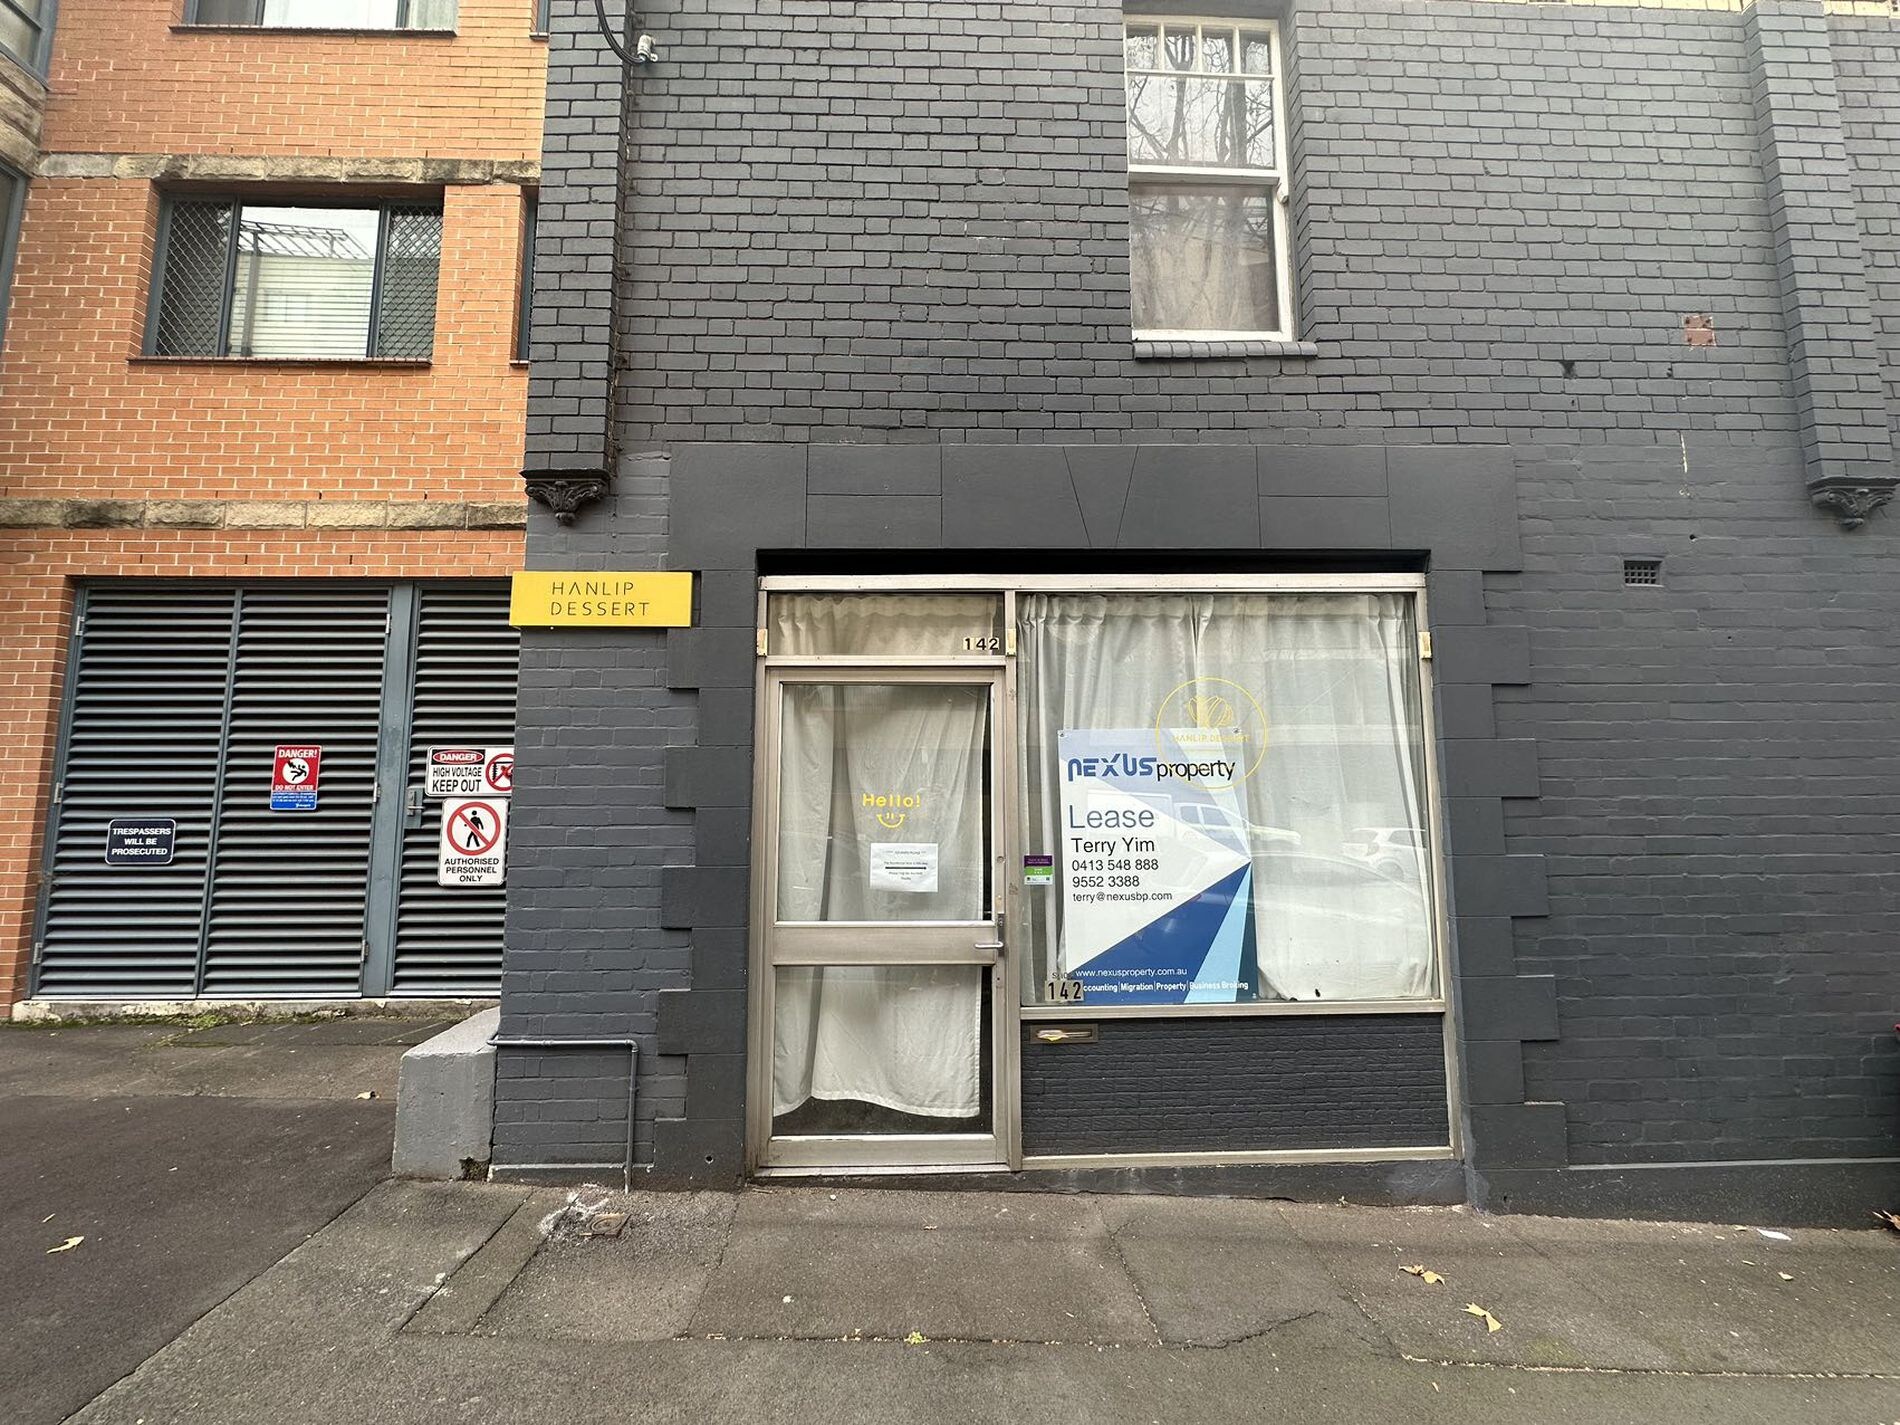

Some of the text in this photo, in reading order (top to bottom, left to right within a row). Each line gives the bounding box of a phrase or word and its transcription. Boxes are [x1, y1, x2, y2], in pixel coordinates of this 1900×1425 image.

[552, 581, 634, 596] HANLIP
[550, 601, 650, 616] DESSERT
[964, 637, 999, 651] 142
[278, 749, 318, 758] DANGER!
[440, 753, 477, 761] DANGER
[433, 767, 482, 777] HIGH VOLTAGE
[1156, 760, 1236, 782] property
[432, 779, 482, 792] KEEP OUT
[862, 793, 920, 808] Hello!
[1069, 804, 1155, 829] Lease
[111, 848, 168, 856] PROSECUTED
[1071, 836, 1155, 857] Terry Yim
[446, 866, 497, 874] PERSONNEL
[1072, 858, 1159, 871] 0413 548 888
[1072, 875, 1140, 888] 9552 3388
[1075, 967, 1188, 978] www.nexusproperty.com.au
[1047, 981, 1083, 1000] 142
[1083, 983, 1118, 993] ccounting
[1120, 982, 1154, 993] Migration
[1156, 981, 1186, 992] Property
